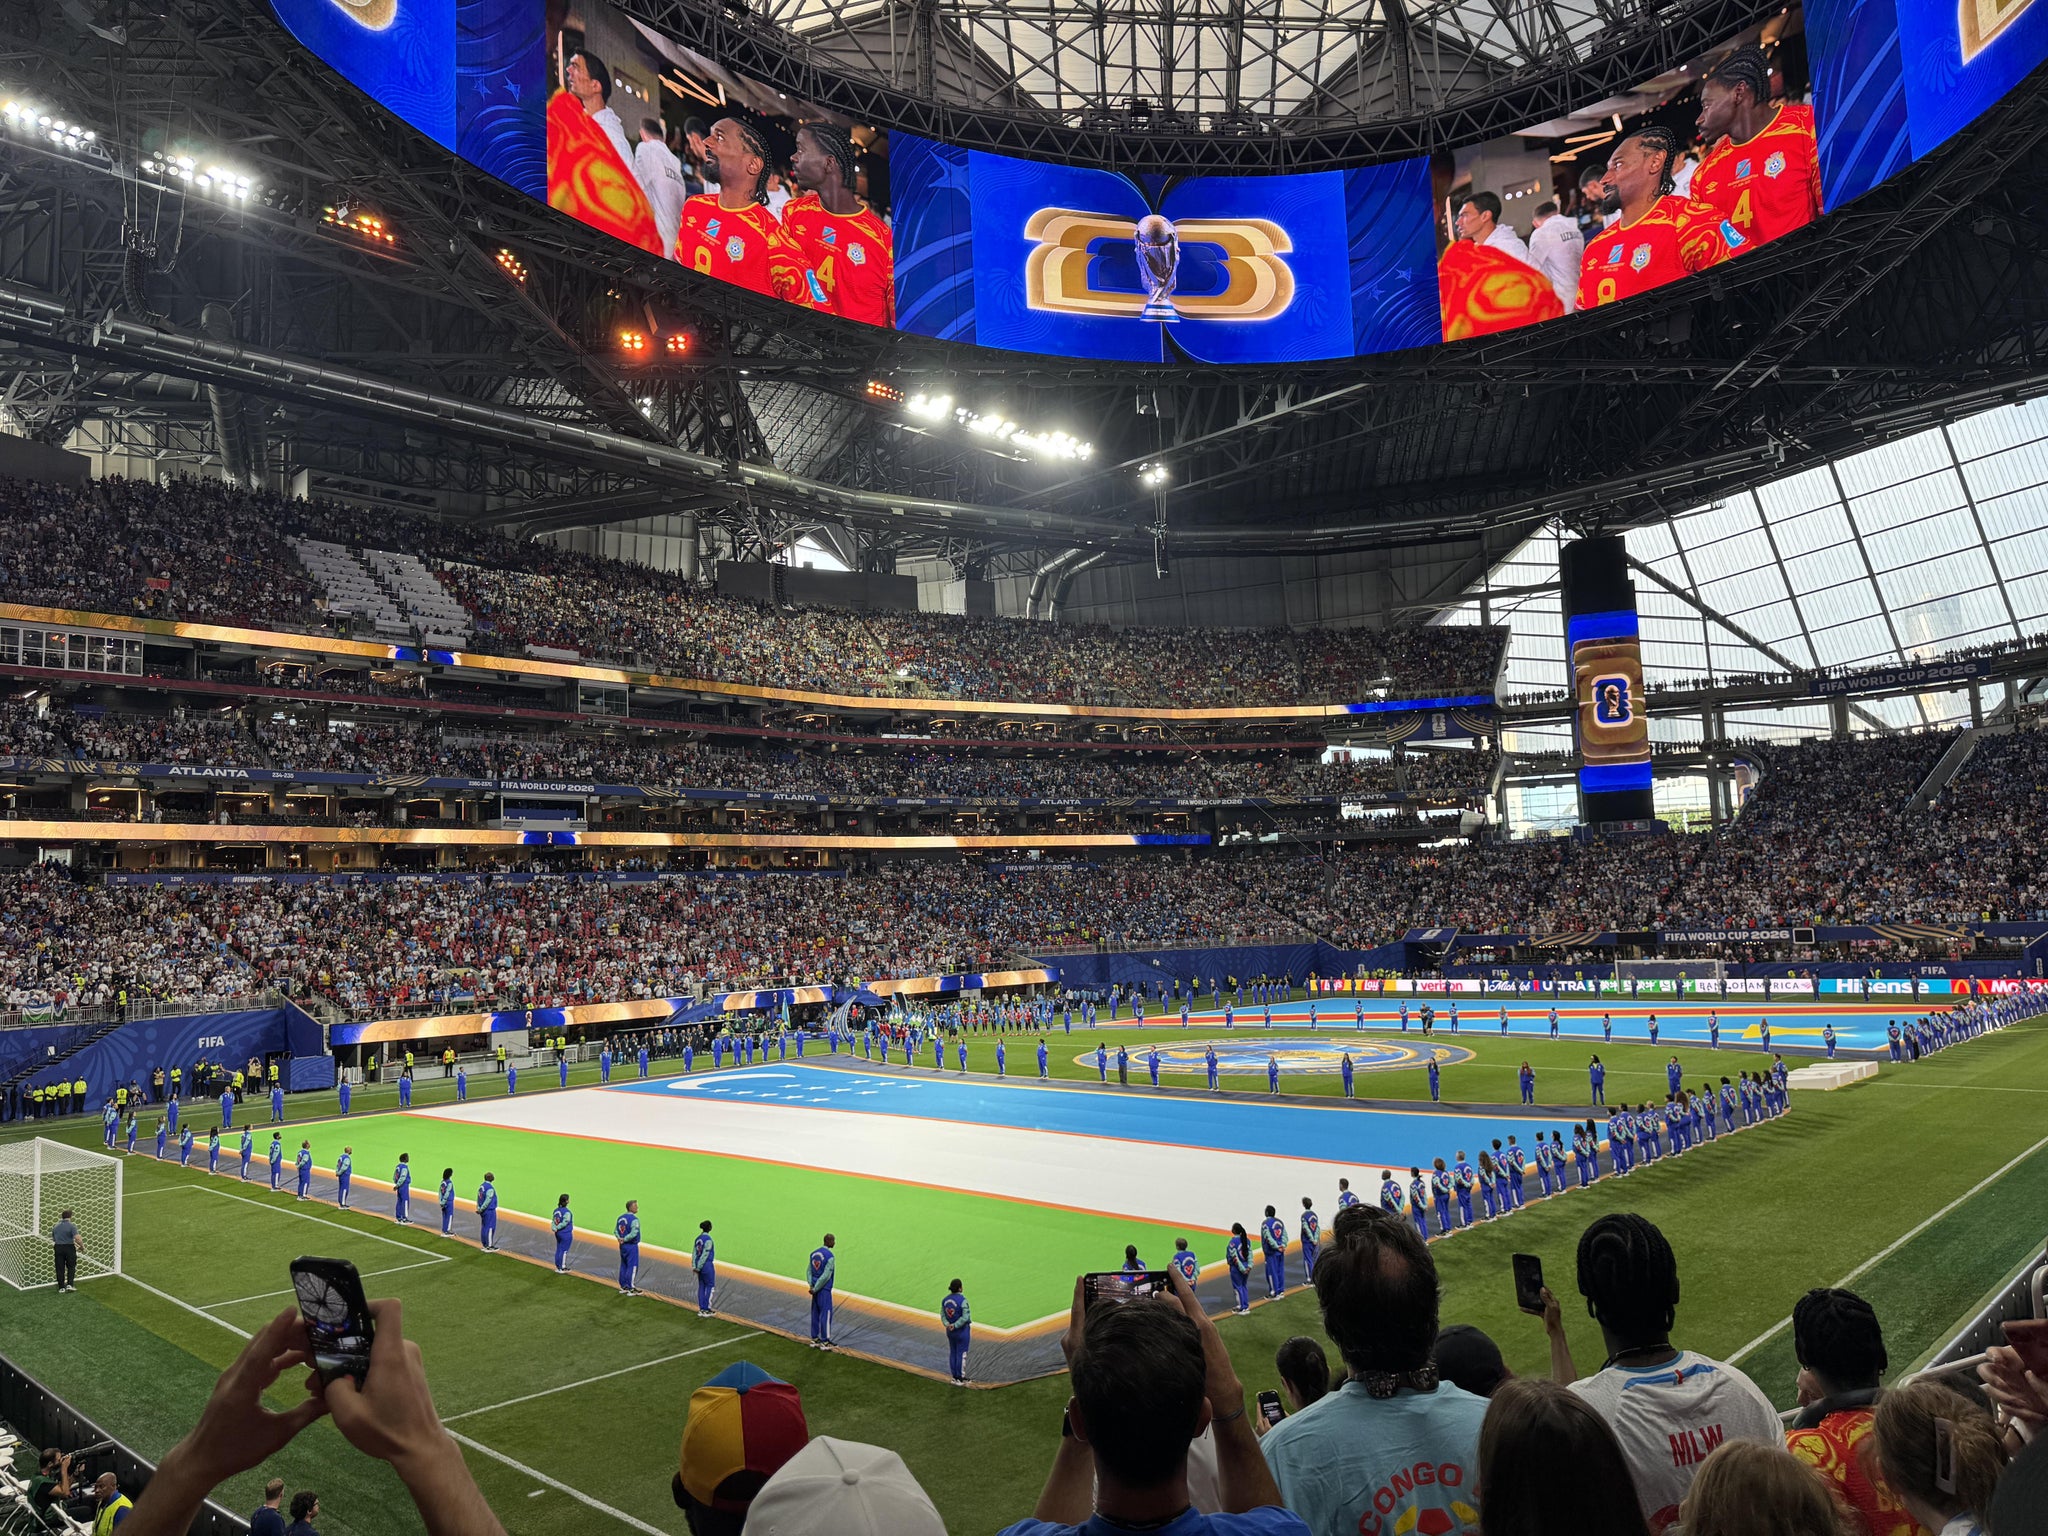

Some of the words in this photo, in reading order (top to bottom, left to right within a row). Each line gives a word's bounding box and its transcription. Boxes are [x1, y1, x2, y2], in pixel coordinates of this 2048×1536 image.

[1731, 188, 1754, 229] 4
[816, 255, 836, 293] 4
[1818, 680, 1846, 693] FIFA
[1848, 675, 1896, 689] WORLD
[1898, 670, 1926, 684] CUP
[1927, 663, 1978, 679] 2026
[168, 766, 249, 778] ATLANTA
[500, 781, 519, 790] FIFA
[519, 782, 550, 791] WORLD
[550, 783, 567, 791] CUP
[567, 784, 595, 793] 2026
[772, 793, 817, 802] ATLANTA
[1341, 793, 1388, 801] ATLANTA
[1664, 932, 1687, 942] FIFA
[1688, 931, 1727, 942] WORLD
[1727, 931, 1750, 940] CUP
[1751, 930, 1791, 940] 2026
[1492, 969, 1510, 977] FIA
[1920, 966, 1947, 975] FIFA
[1324, 977, 1343, 991] Ly's
[1420, 980, 1463, 992] verizon
[1489, 980, 1530, 992] Michlob
[1542, 980, 1587, 992] UTRA
[1748, 981, 1800, 990] AMRICA
[198, 1036, 225, 1049] FIFA
[1668, 1423, 1724, 1467] MLW
[1358, 1461, 1464, 1536] CONGO
